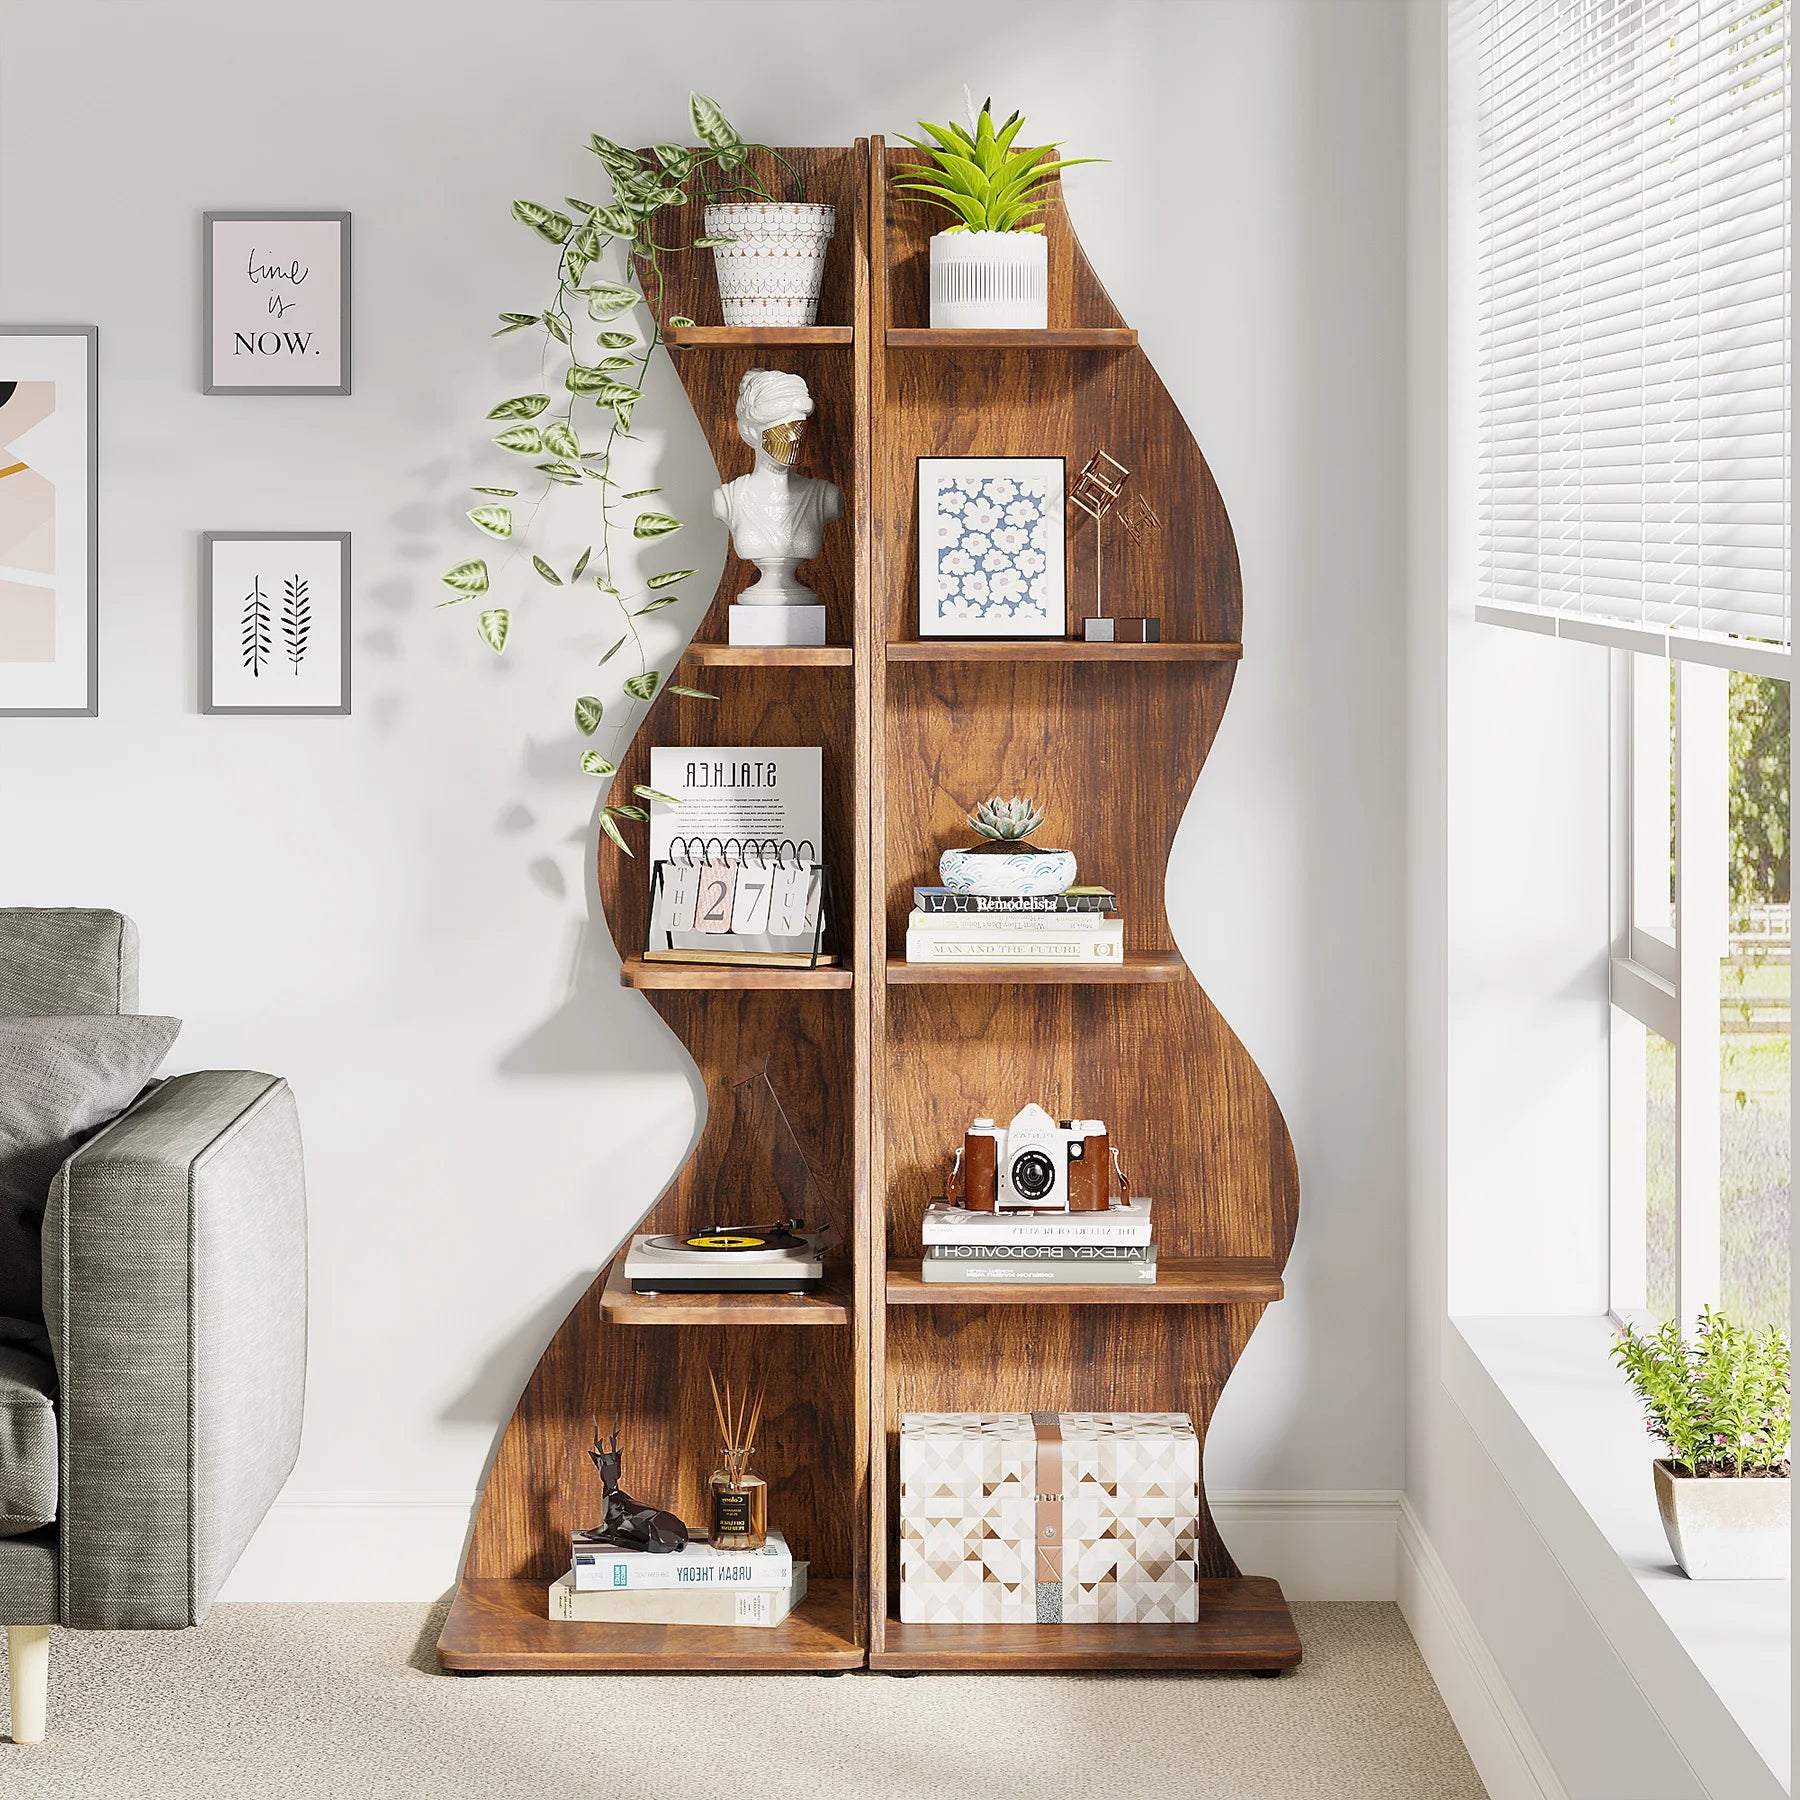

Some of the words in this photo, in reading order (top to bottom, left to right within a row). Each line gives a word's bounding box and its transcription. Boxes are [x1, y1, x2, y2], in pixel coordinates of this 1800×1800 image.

[247, 248, 309, 285] time
[268, 288, 296, 319] is
[232, 331, 320, 356] NOW.
[976, 896, 1058, 911] Remodelista
[934, 945, 963, 954] MAN
[966, 945, 995, 954] AND
[999, 945, 1026, 954] THE
[1030, 945, 1081, 954] FUTURE
